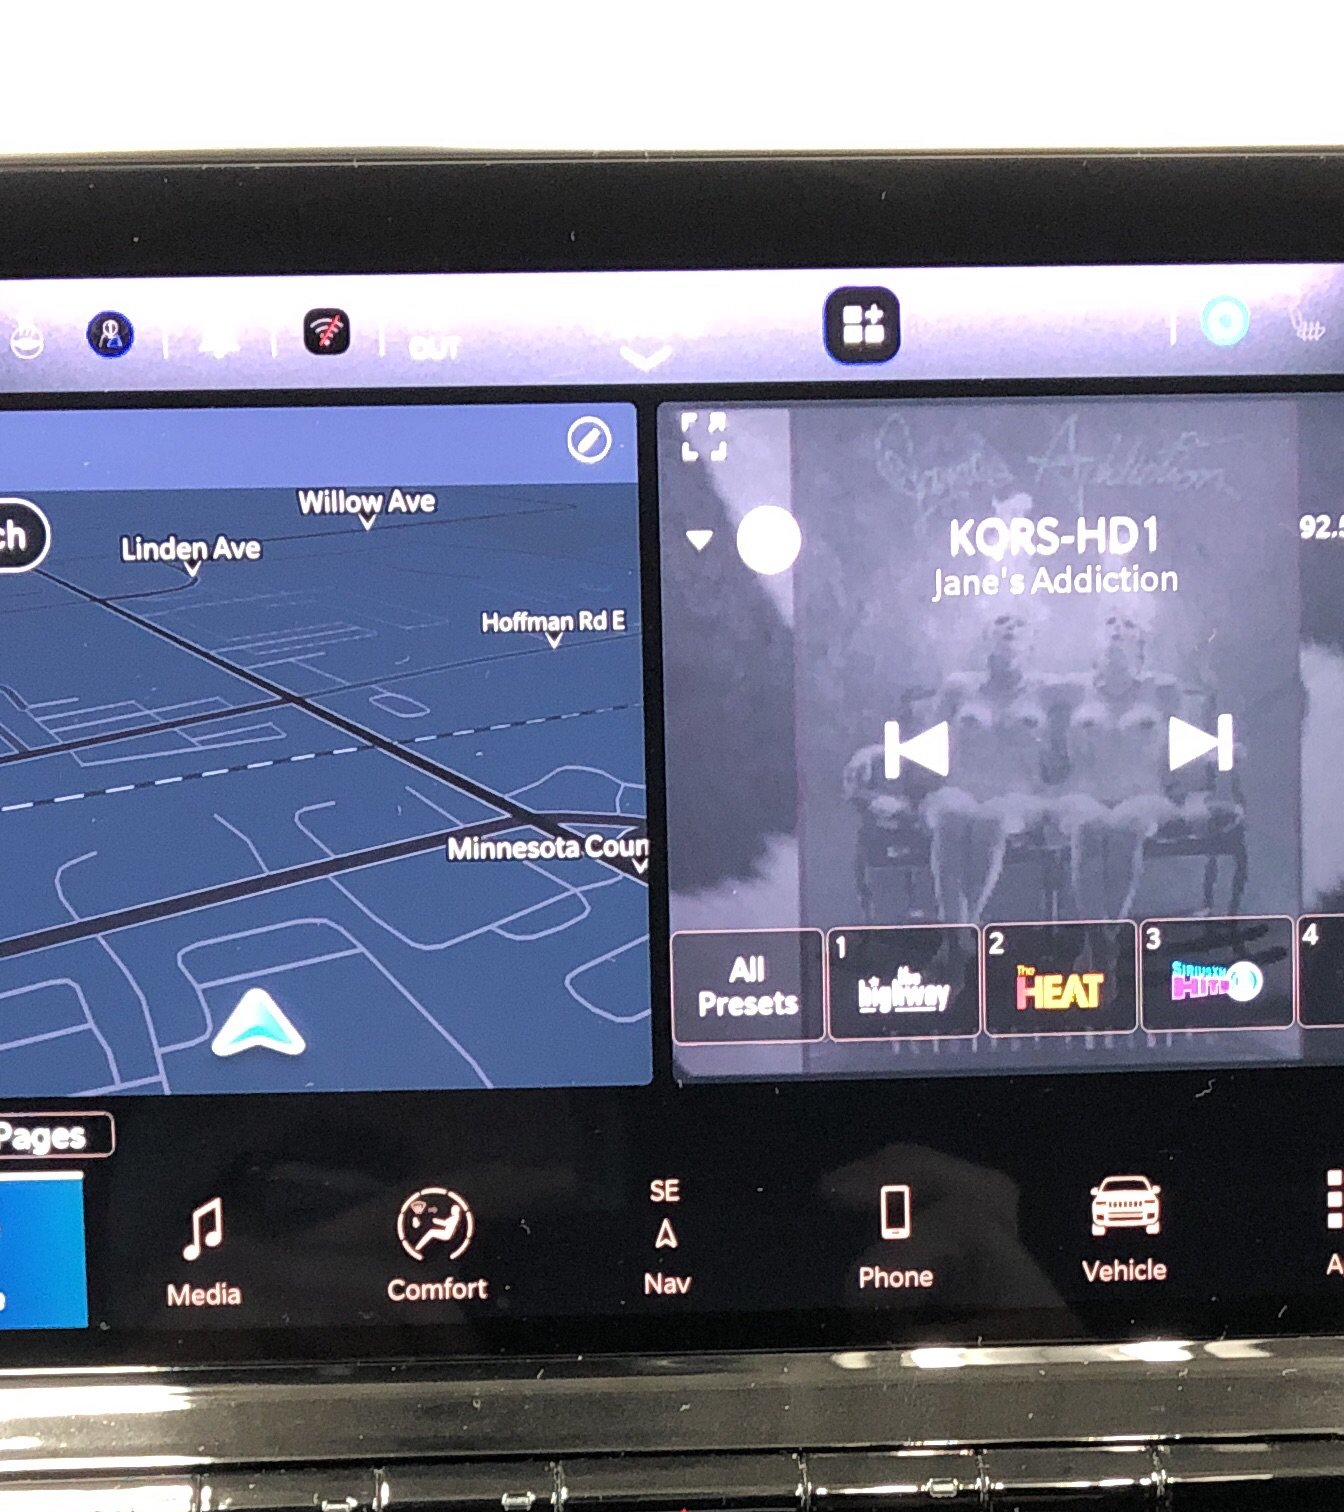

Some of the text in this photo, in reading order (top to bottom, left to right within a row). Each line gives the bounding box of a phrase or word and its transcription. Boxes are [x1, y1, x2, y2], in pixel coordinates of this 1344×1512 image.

[299, 489, 436, 515] Willow Ave
[122, 535, 262, 561] Linden Ave
[950, 515, 1158, 561] KQRS-HD1
[933, 564, 1179, 602] Jane's Addiction
[481, 610, 626, 634] Hoffman Rd E
[447, 834, 650, 861] Minnesota Coun
[989, 932, 1005, 955] 2
[1146, 928, 1161, 950] 3
[1302, 923, 1319, 946] 4
[836, 938, 846, 959] 1
[728, 956, 764, 983] All
[698, 990, 799, 1016] Presets
[1017, 971, 1104, 1011] HEAT
[650, 1178, 679, 1202] SE
[858, 1264, 934, 1289] Phone
[1082, 1257, 1167, 1283] Vehicle
[167, 1282, 242, 1307] Media
[387, 1276, 488, 1301] Comfort
[644, 1272, 691, 1296] Nav
